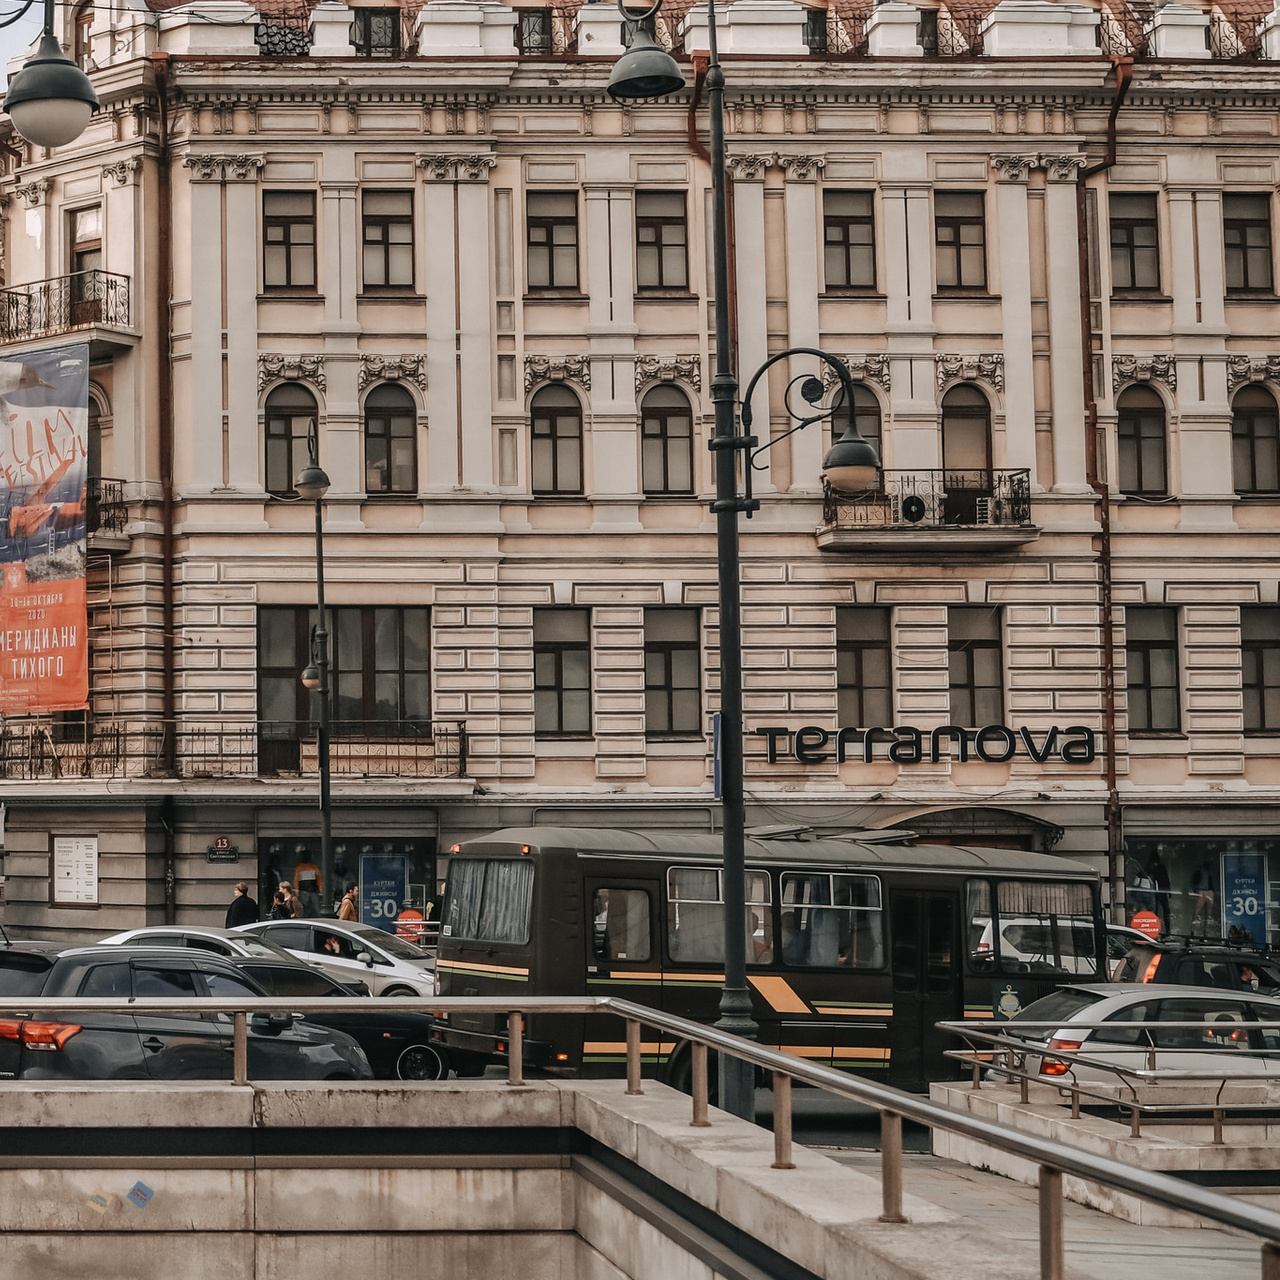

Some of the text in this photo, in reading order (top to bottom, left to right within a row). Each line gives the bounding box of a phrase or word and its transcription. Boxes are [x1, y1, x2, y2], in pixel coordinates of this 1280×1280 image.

[33, 594, 63, 605] ОКТЯБРЯ
[28, 609, 46, 620] 2020
[11, 655, 64, 679] ТИХОГО
[217, 839, 228, 848] 13
